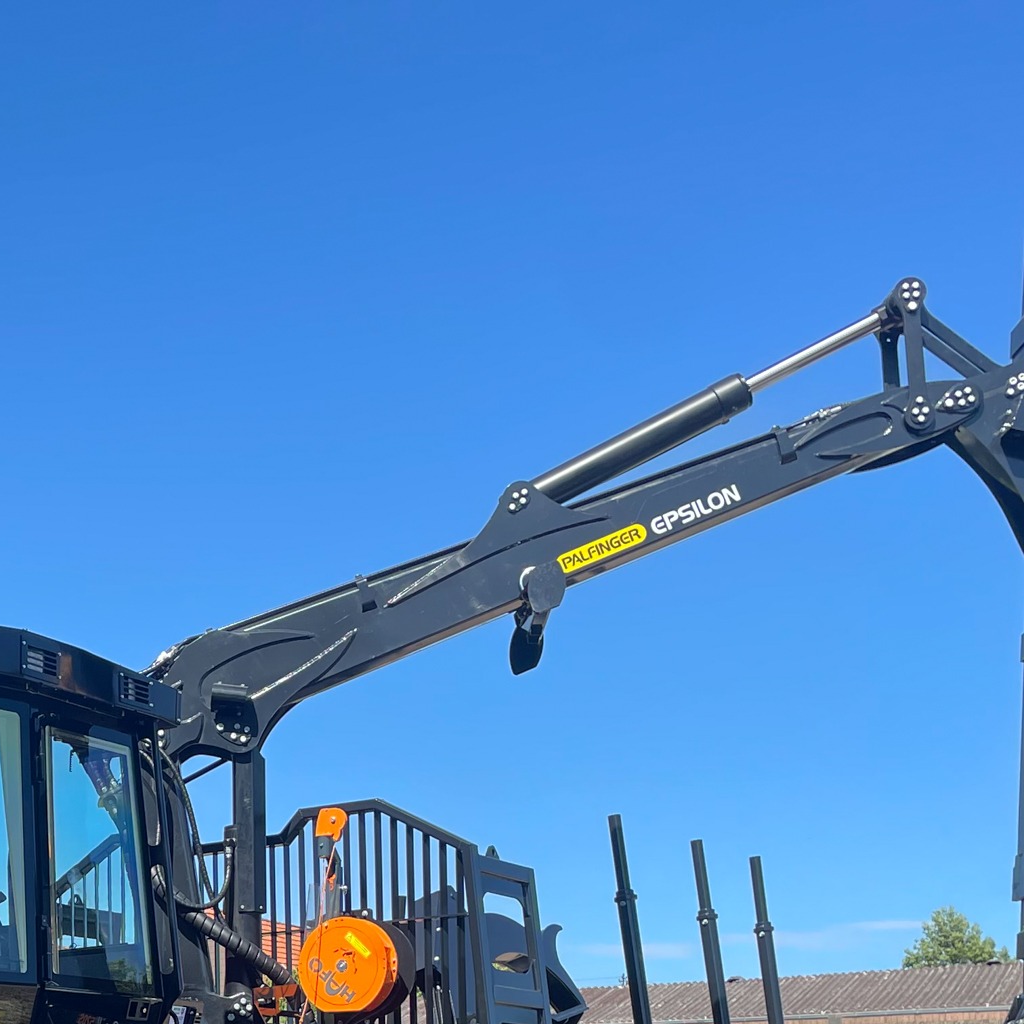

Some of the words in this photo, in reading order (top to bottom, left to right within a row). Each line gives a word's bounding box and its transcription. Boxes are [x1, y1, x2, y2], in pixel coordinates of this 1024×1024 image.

[562, 528, 642, 570] PALFINGER
[650, 484, 742, 535] EPSILON
[308, 957, 356, 1004] HAFO
